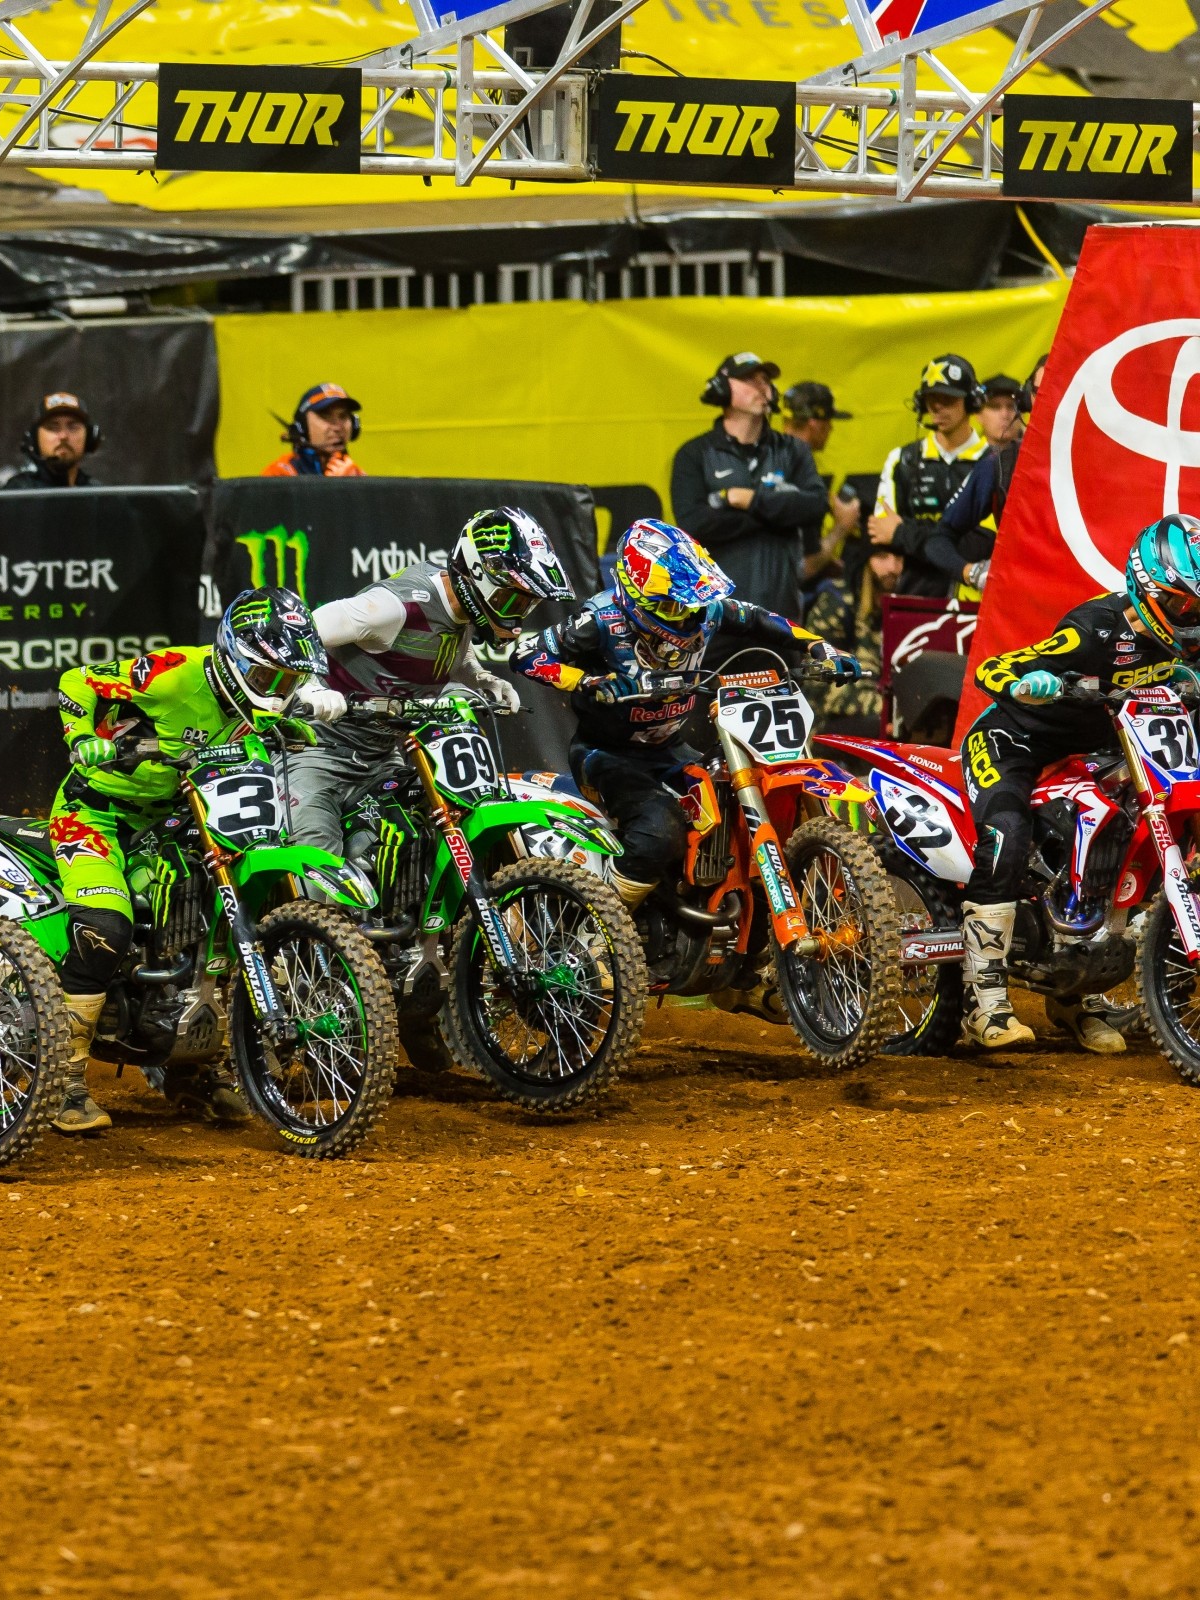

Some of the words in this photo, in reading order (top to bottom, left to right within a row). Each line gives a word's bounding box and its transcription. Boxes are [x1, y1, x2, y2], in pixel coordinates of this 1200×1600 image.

[662, 0, 842, 29] IRES
[174, 90, 346, 147] THOR
[615, 100, 780, 157] THOR
[1018, 120, 1178, 176] THOR
[352, 542, 448, 582] MONS
[1132, 548, 1163, 598] 100%
[457, 575, 480, 617] MONSTER
[1139, 602, 1174, 645] GEICO
[725, 677, 776, 687] RENTHAL
[631, 706, 667, 722] Red
[668, 695, 695, 717] Bull
[742, 699, 807, 752] 25
[441, 736, 495, 788] 69
[907, 754, 943, 773] HONDA
[1148, 718, 1199, 770] 32
[216, 776, 276, 832] 3
[447, 835, 472, 884] SHOW
[761, 863, 784, 912] MOTOREX
[476, 898, 508, 967] DUNLOP
[239, 942, 268, 1013] DUNLOP
[262, 969, 279, 1010] CARRILLO
[280, 1129, 319, 1145] DUNLOP
